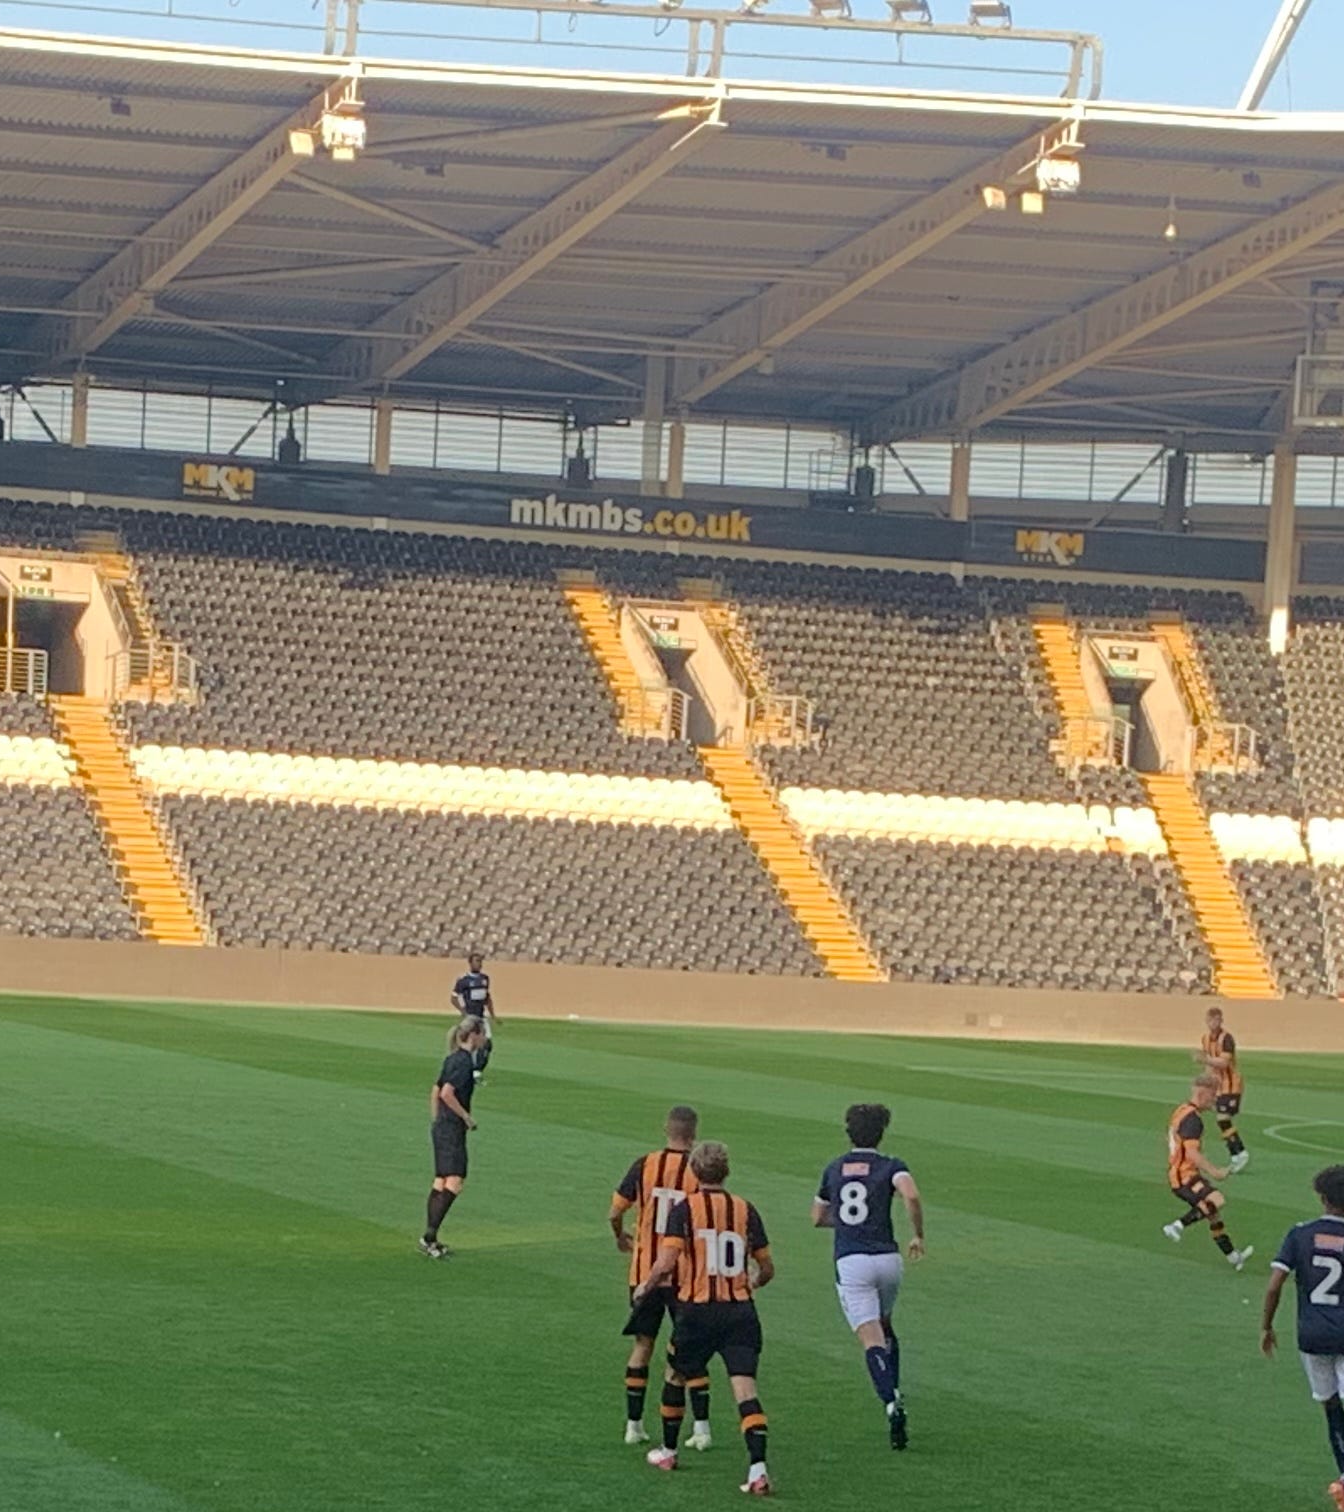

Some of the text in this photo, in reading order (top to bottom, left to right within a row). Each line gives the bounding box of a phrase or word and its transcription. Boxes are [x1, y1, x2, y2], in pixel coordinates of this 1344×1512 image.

[183, 463, 255, 501] MKM
[510, 494, 752, 542] mkmbs.co.uk
[1017, 529, 1085, 566] MKM
[839, 1181, 869, 1226] 8
[697, 1228, 746, 1277] 10
[1310, 1255, 1343, 1306] 2
